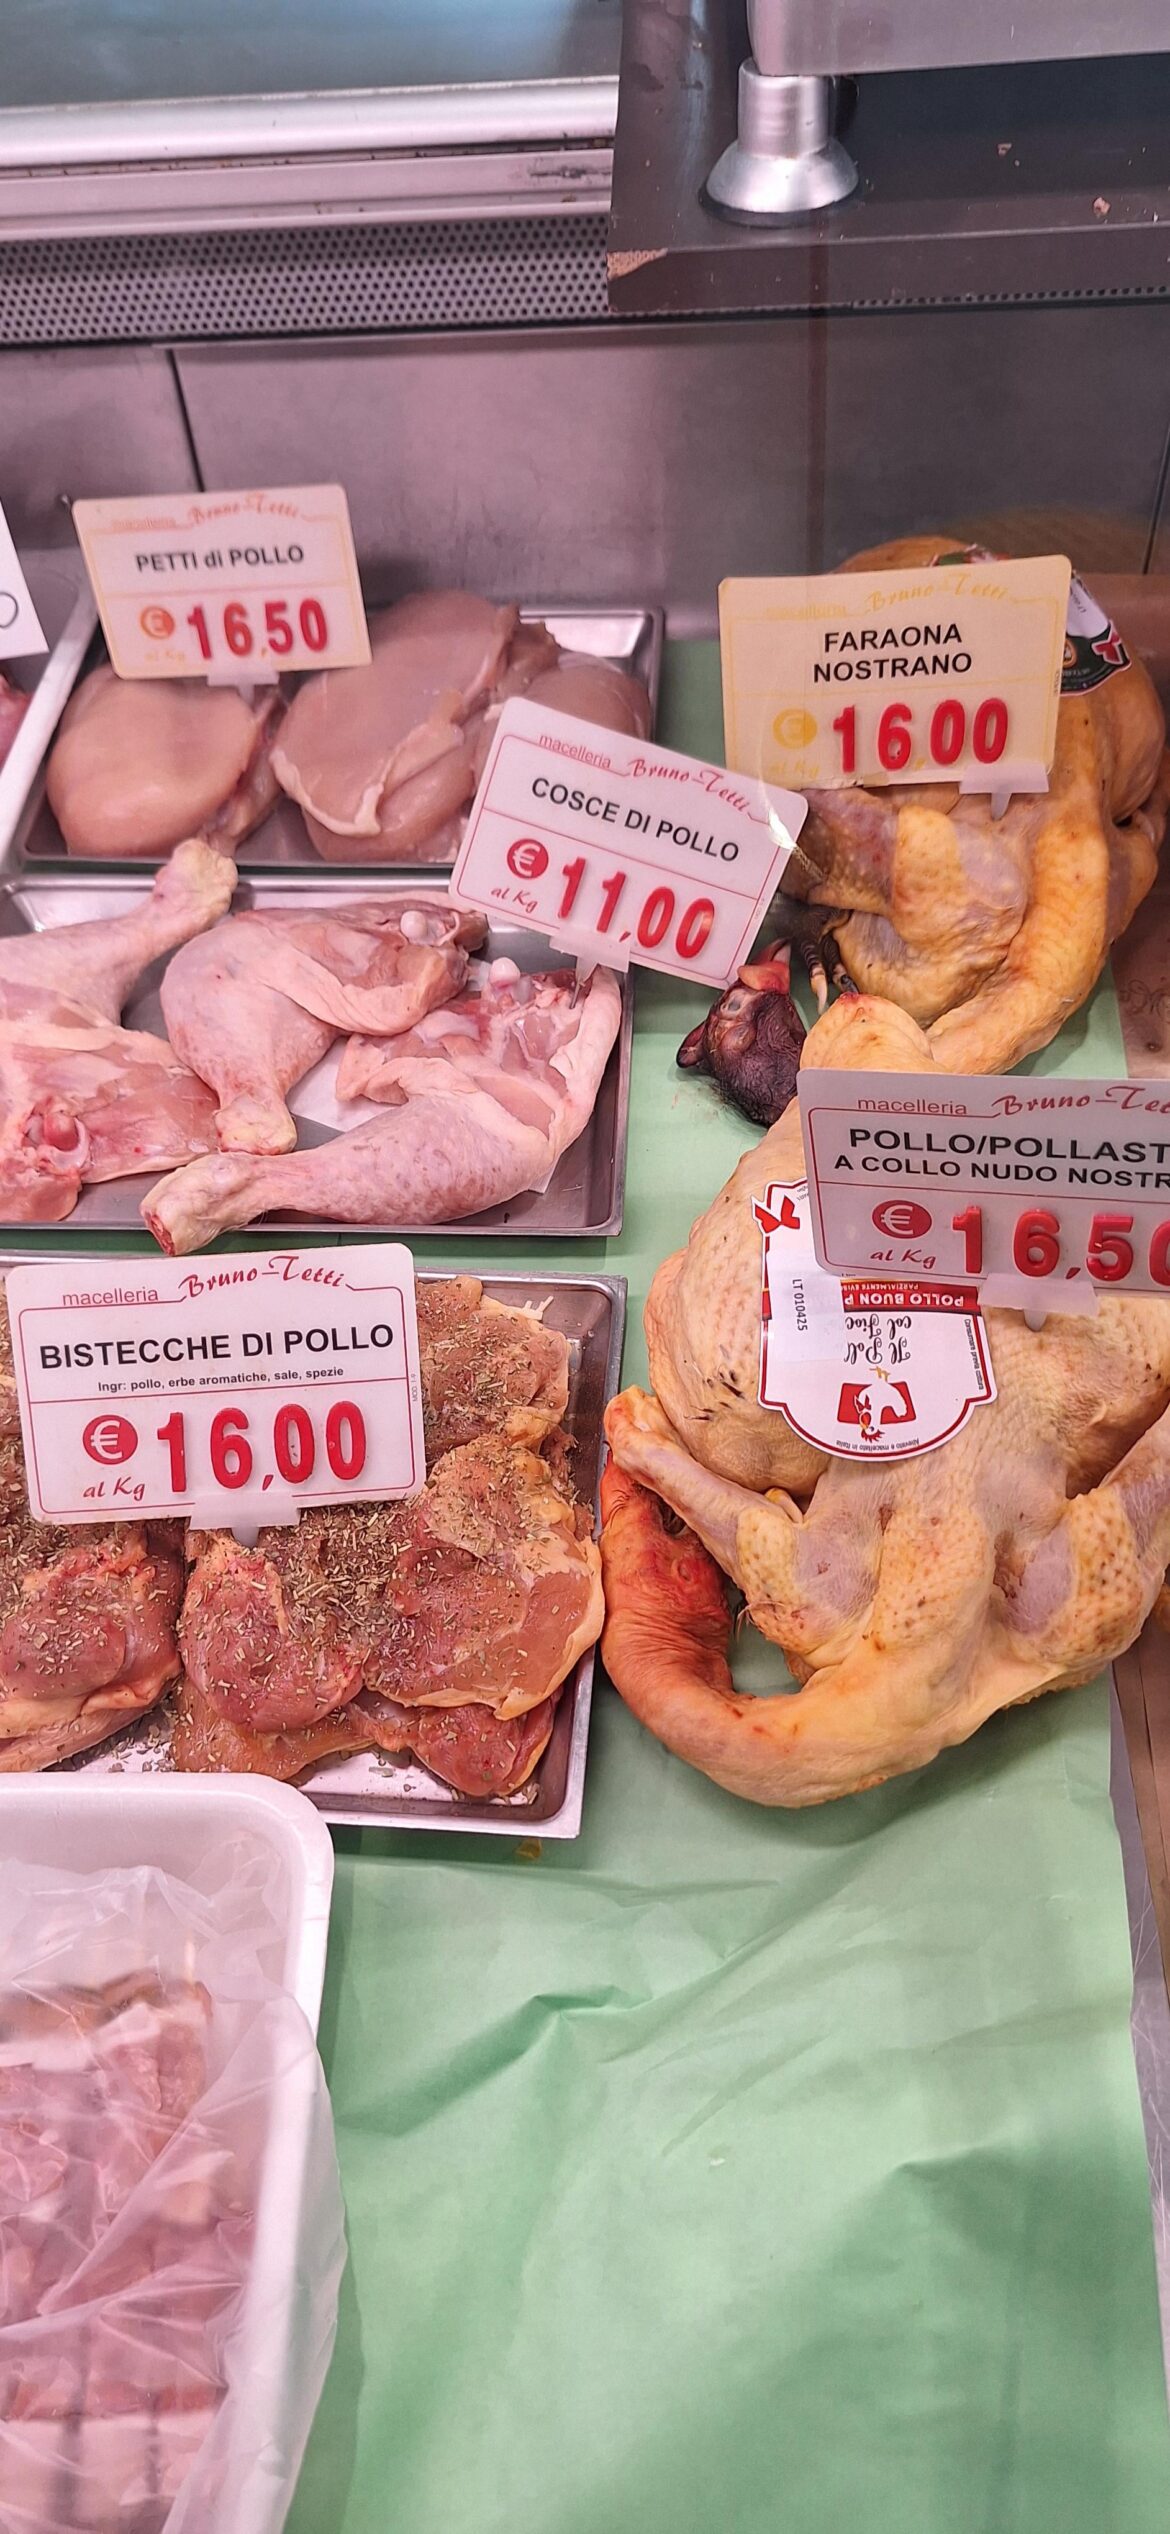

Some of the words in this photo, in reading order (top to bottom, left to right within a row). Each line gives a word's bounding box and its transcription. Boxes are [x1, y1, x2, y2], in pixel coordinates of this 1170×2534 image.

[135, 553, 198, 573] PETTI
[204, 551, 223, 568] di
[229, 545, 304, 565] POLLO
[824, 622, 963, 654] FARAONA
[813, 652, 973, 684] NOSTRANO
[538, 733, 612, 769] macelleria
[531, 777, 620, 823] COSCE
[624, 809, 651, 833] DI
[655, 820, 740, 862] POLLO
[491, 886, 508, 900] al
[513, 891, 539, 914] Kg
[558, 856, 715, 959] 11,00
[857, 1099, 968, 1115] macelleria
[849, 1128, 1170, 1165] POLLO/POLLAST
[834, 1155, 854, 1171] A
[861, 1156, 961, 1177] COLLO
[970, 1162, 1058, 1182] NUDO
[1068, 1167, 1170, 1189] NOSTR
[870, 1248, 894, 1262] al
[902, 1249, 937, 1270] Kg
[62, 1286, 159, 1307] macelleria
[792, 1278, 803, 1290] LT
[859, 1292, 907, 1305] BUON
[794, 1293, 808, 1331] 010425
[910, 1293, 964, 1308] POLLO
[40, 1334, 231, 1369] BISTECCHE
[242, 1331, 274, 1358] DI
[284, 1323, 394, 1355] POLLO
[98, 1380, 127, 1393] Ingr:
[130, 1376, 166, 1391] pollo,
[168, 1375, 195, 1388] erbe
[199, 1370, 272, 1386] aromatiche,
[274, 1368, 303, 1382] sale,
[305, 1366, 344, 1381] spezie
[157, 1400, 367, 1493] 16,00
[83, 1481, 104, 1498] al
[113, 1476, 146, 1500] Kg
